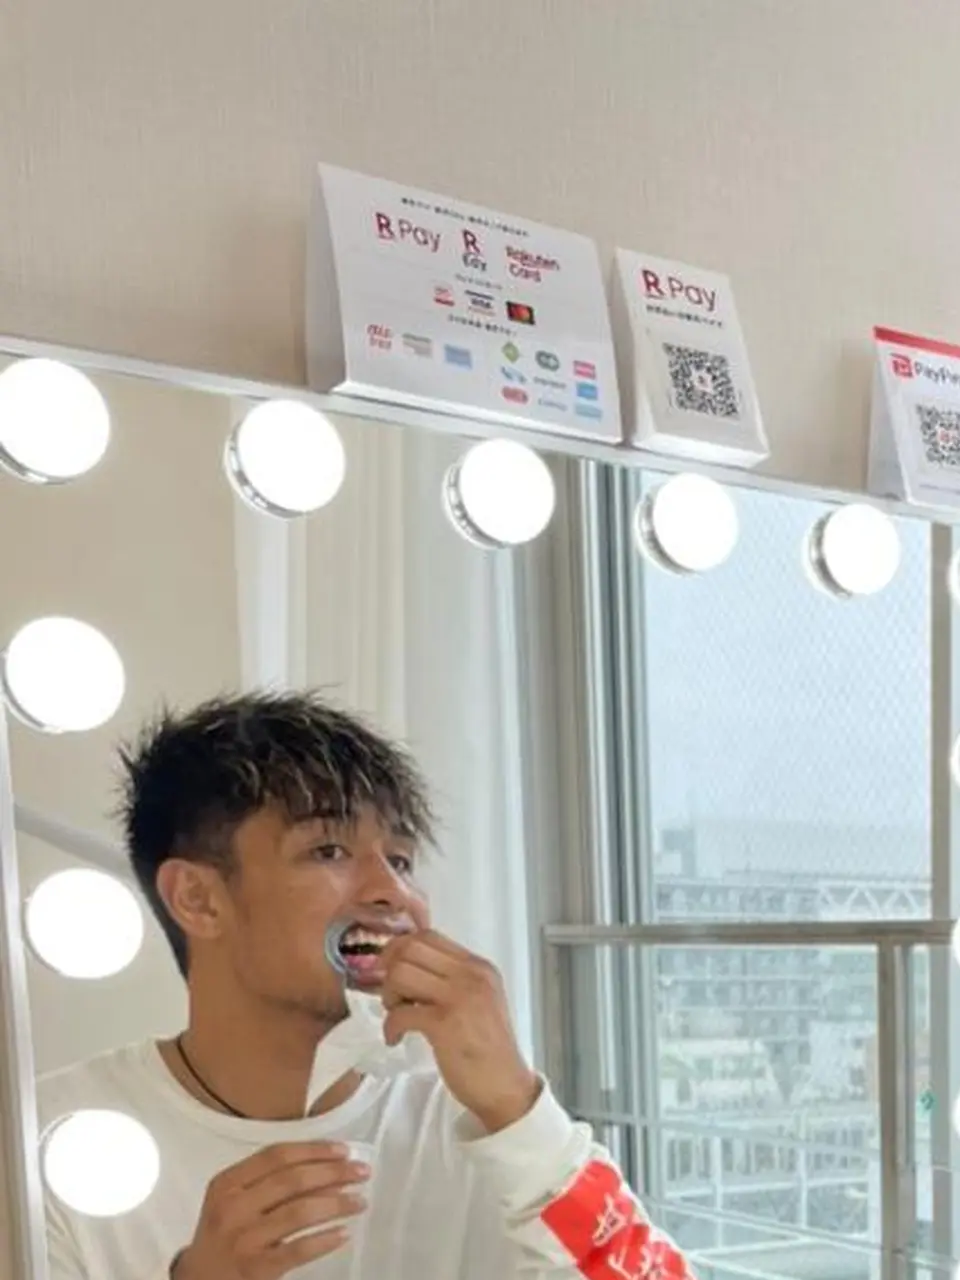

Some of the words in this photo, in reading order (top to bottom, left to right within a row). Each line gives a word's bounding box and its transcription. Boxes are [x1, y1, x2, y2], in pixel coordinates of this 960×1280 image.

[398, 218, 441, 254] Pay
[641, 269, 666, 299] R
[667, 276, 716, 312] Pay
